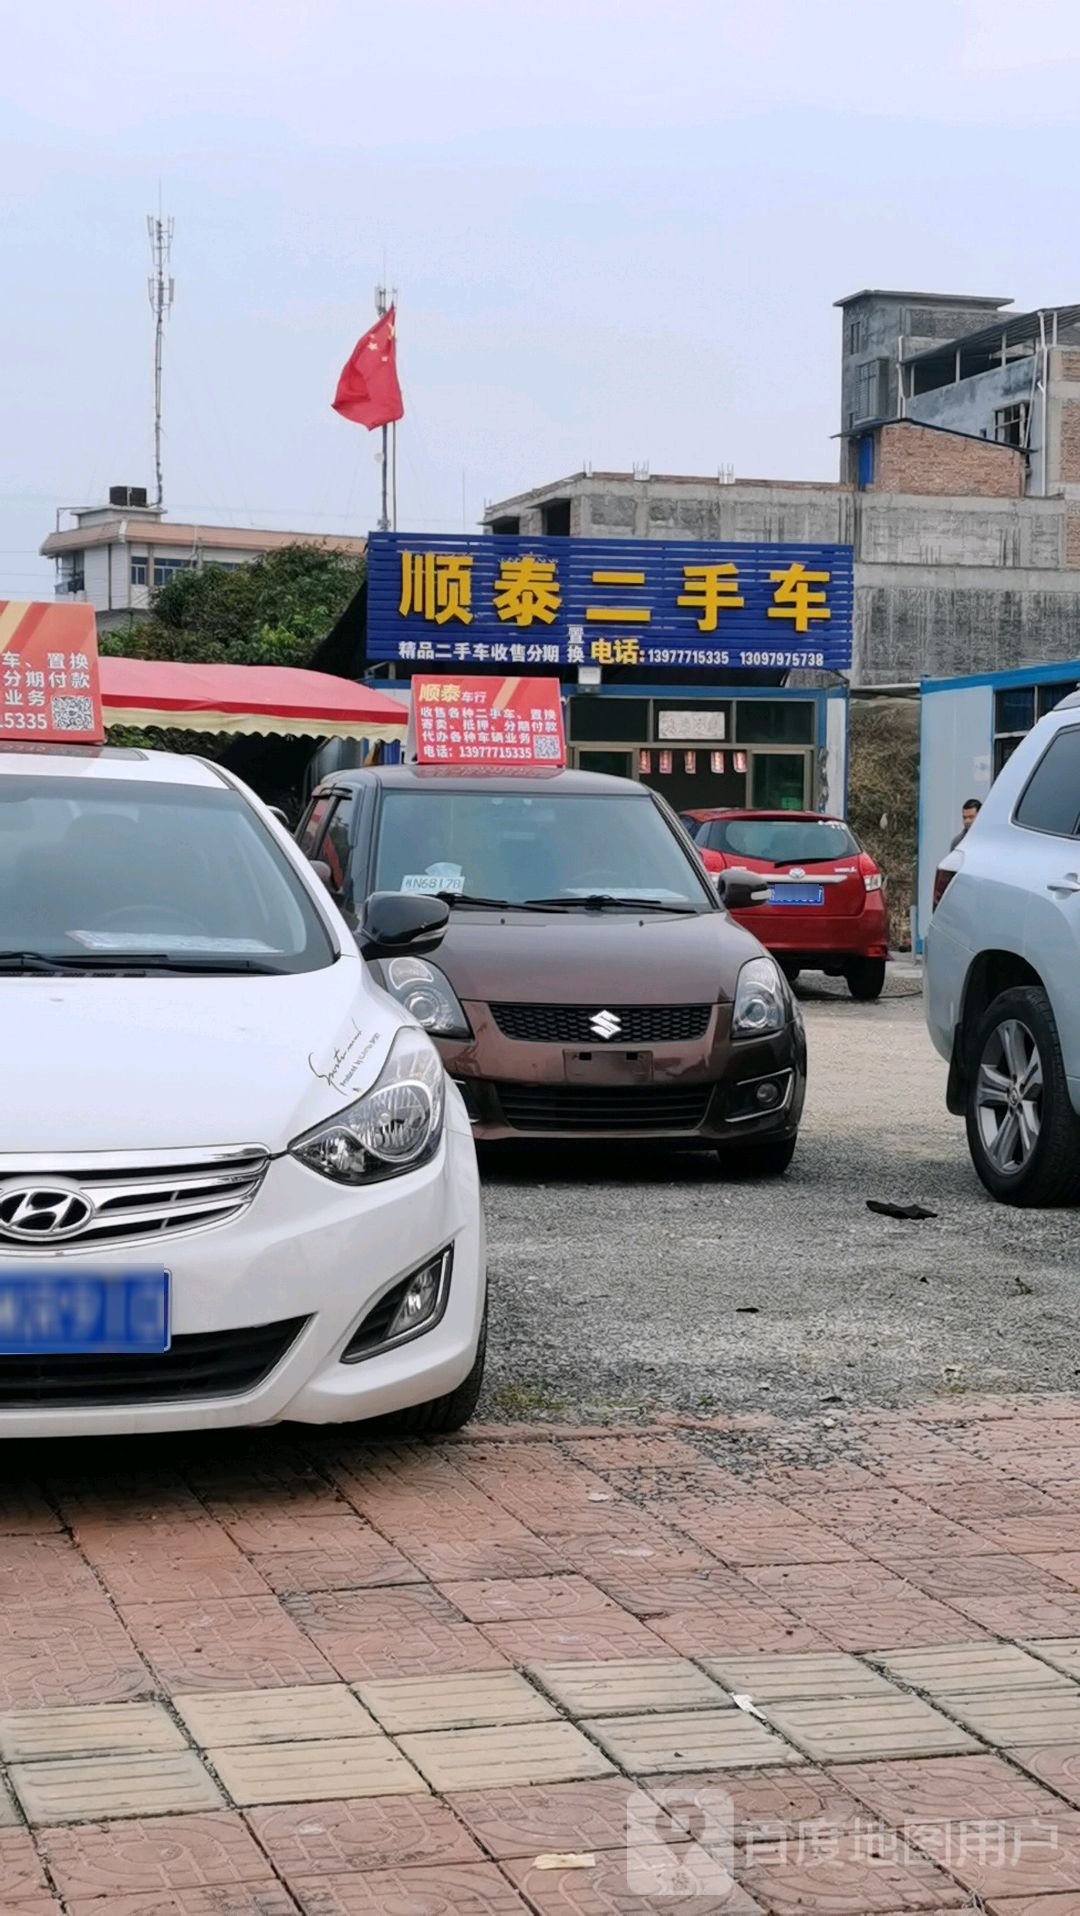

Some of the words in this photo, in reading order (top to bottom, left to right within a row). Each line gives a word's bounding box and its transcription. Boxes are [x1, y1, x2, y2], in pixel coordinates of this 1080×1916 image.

[399, 551, 831, 632] 顺泰二手车
[398, 640, 559, 662] 精品二手车收售分期
[739, 651, 823, 667] 13097975738
[3, 670, 90, 689] 分期付款
[4, 689, 46, 707] 业务
[0, 712, 47, 730] 5335
